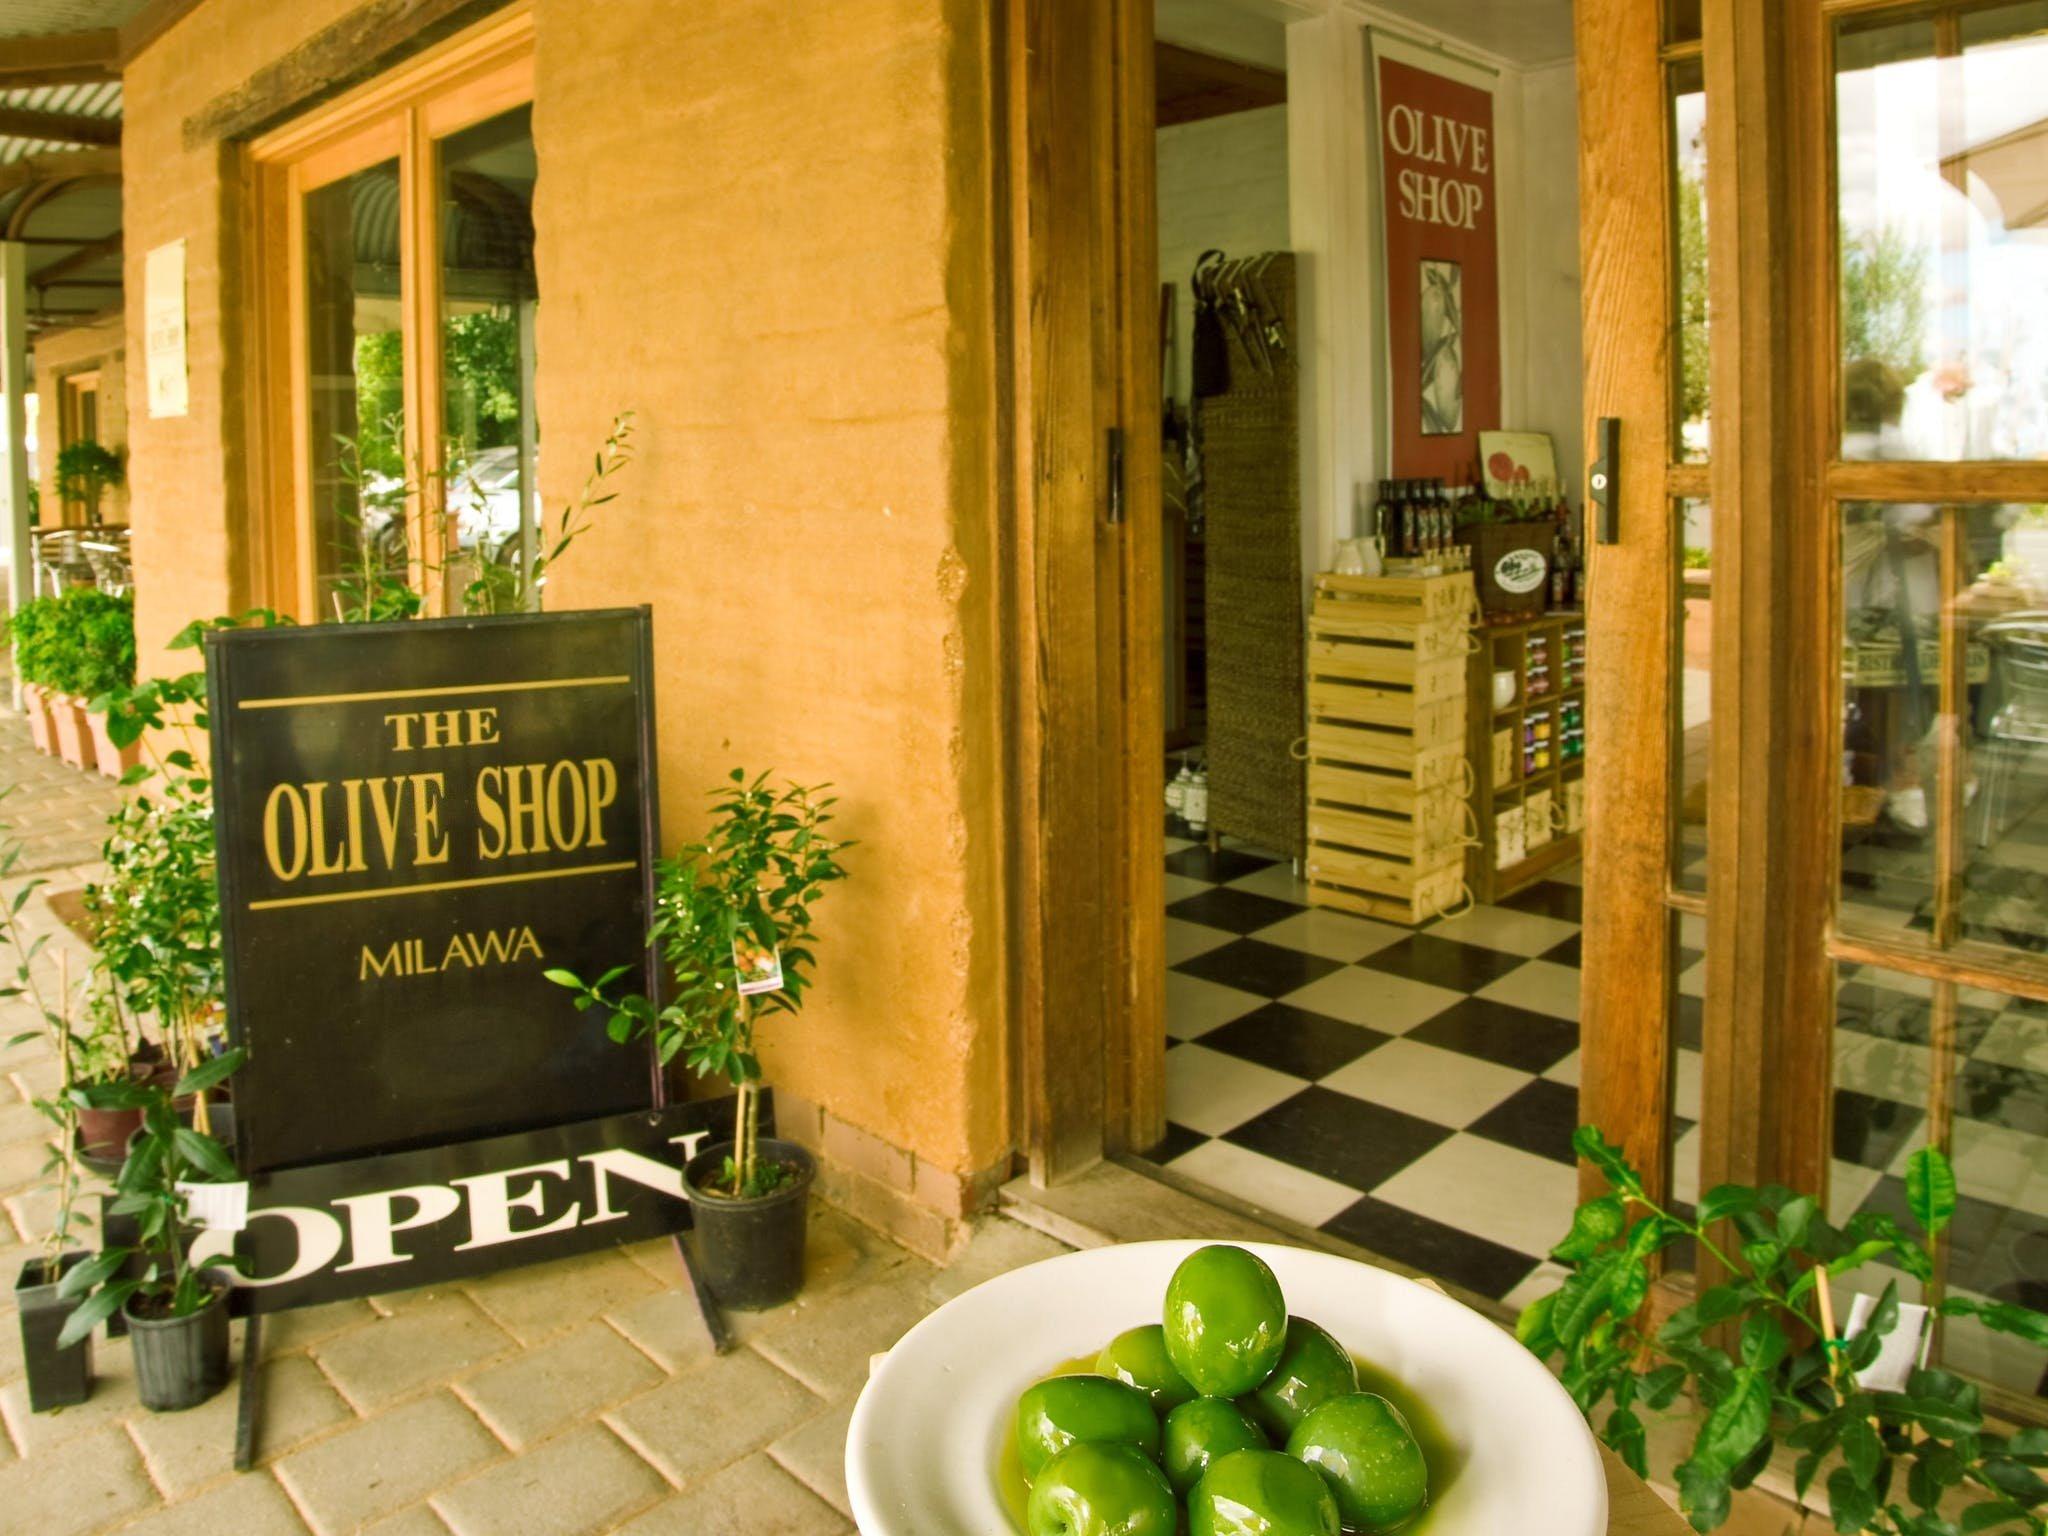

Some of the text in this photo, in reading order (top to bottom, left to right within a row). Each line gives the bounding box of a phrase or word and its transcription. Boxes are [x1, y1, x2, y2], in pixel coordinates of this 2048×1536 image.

[1388, 104, 1489, 173] OLIVE
[1399, 168, 1483, 229] SHOP
[384, 707, 500, 752] THE
[263, 757, 617, 882] OLIVE SHOP
[359, 925, 544, 981] MILAWA
[189, 1130, 710, 1288] OPEN
